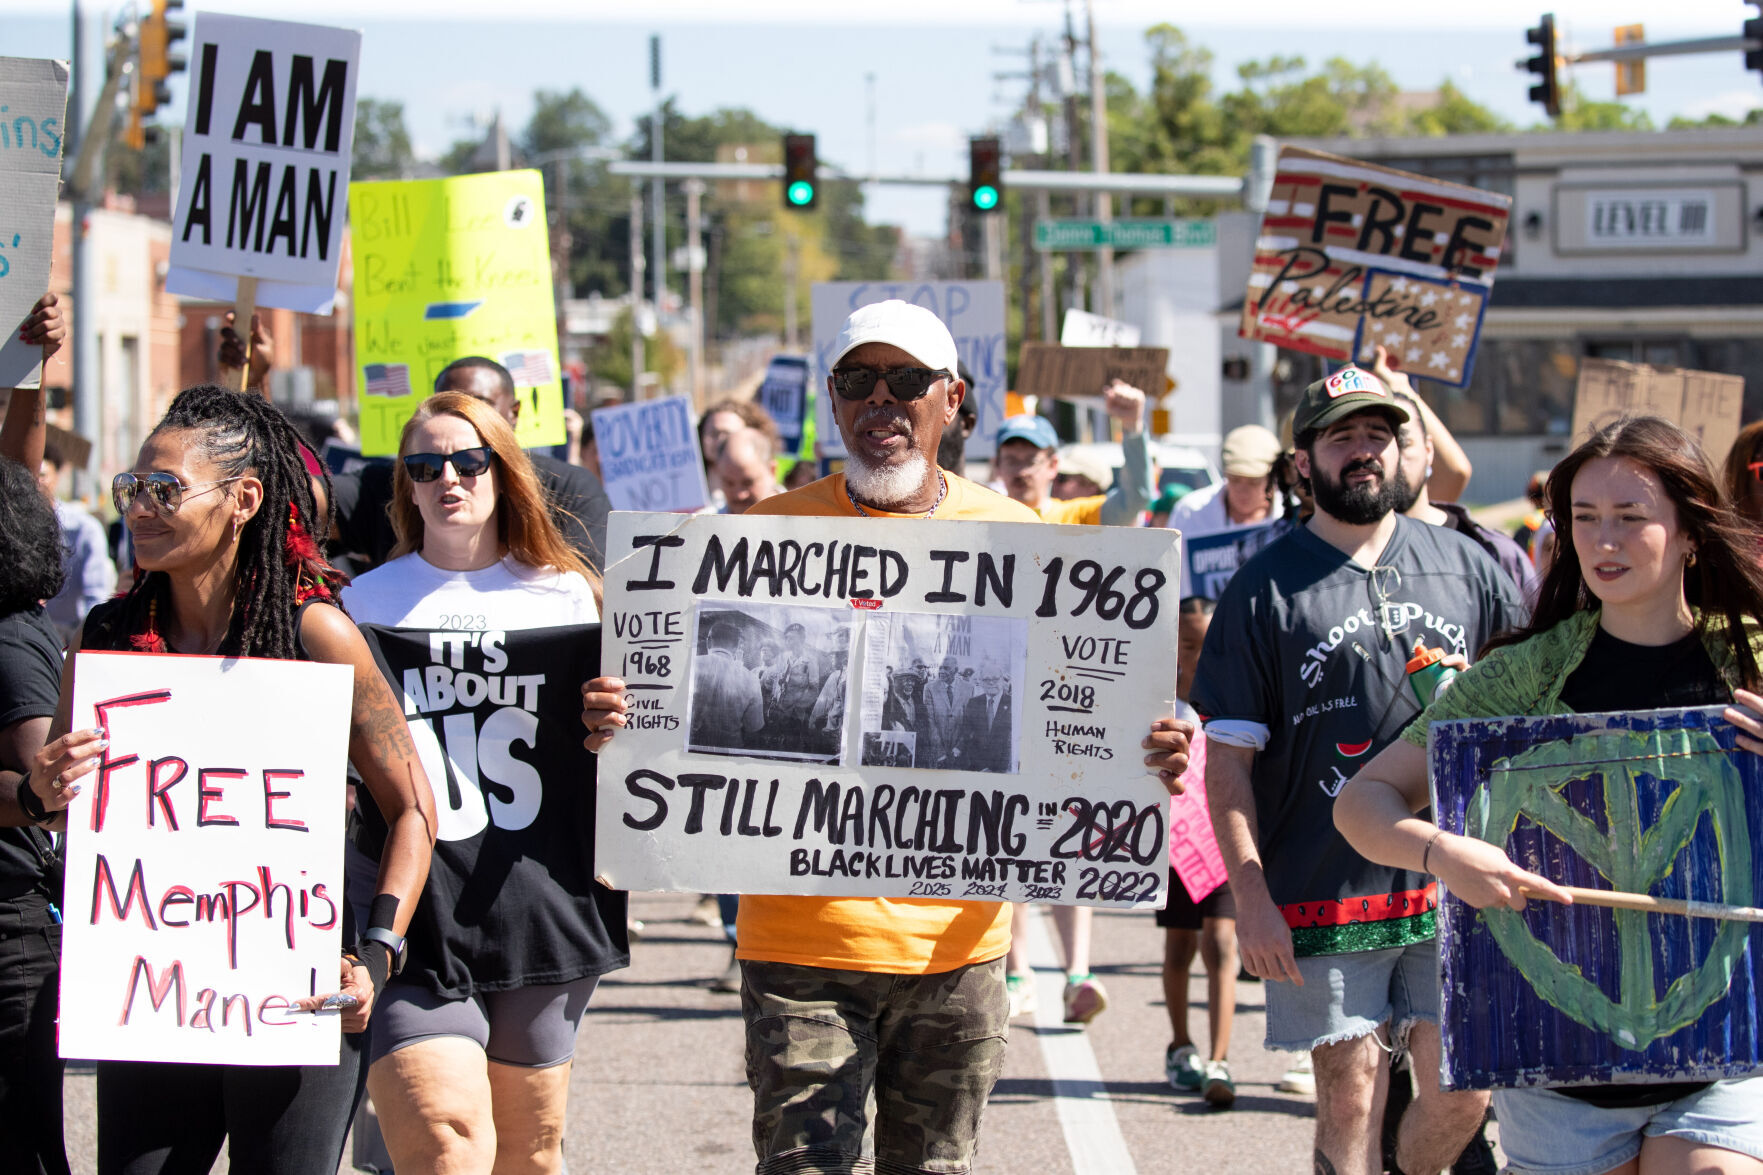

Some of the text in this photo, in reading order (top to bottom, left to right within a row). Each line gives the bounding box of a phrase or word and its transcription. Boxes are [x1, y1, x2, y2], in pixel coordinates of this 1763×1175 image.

[195, 43, 347, 153] I AM
[182, 153, 337, 261] A MAN
[359, 192, 411, 241] Bill
[1594, 200, 1669, 237] LEVEL
[1312, 184, 1493, 277] FREE
[1259, 247, 1441, 331] Palestine
[1331, 370, 1356, 388] GO
[626, 470, 684, 509] NOT
[626, 535, 685, 591] I
[692, 534, 909, 599] MARCHED
[925, 551, 1016, 608] IN
[1035, 556, 1166, 629] 1968
[438, 614, 487, 630] 2023
[614, 611, 684, 638] VOTE
[429, 631, 508, 674] IT'S
[623, 652, 671, 678] 1968
[1061, 635, 1131, 665] VOTE
[1301, 608, 1376, 688] Shoot
[403, 665, 546, 716] ABOUT
[625, 693, 665, 710] CIVIL
[1040, 680, 1095, 709] 2018
[1335, 696, 1358, 708] FREE
[624, 713, 679, 731] RIGHTS
[1045, 721, 1106, 739] HUMAN
[90, 688, 309, 833] FREE
[1052, 739, 1113, 760] RIGHTS
[407, 706, 543, 842] US
[623, 769, 783, 837] STILL
[793, 778, 1029, 857] MARCHING
[1038, 802, 1058, 817] IN
[1050, 797, 1163, 866] 2020
[790, 848, 1066, 885] BLACK LIVES MATTER
[1076, 866, 1160, 902] 2022
[909, 881, 953, 896] 2025
[90, 854, 338, 970] Memphis
[118, 954, 318, 1037] Mane!
